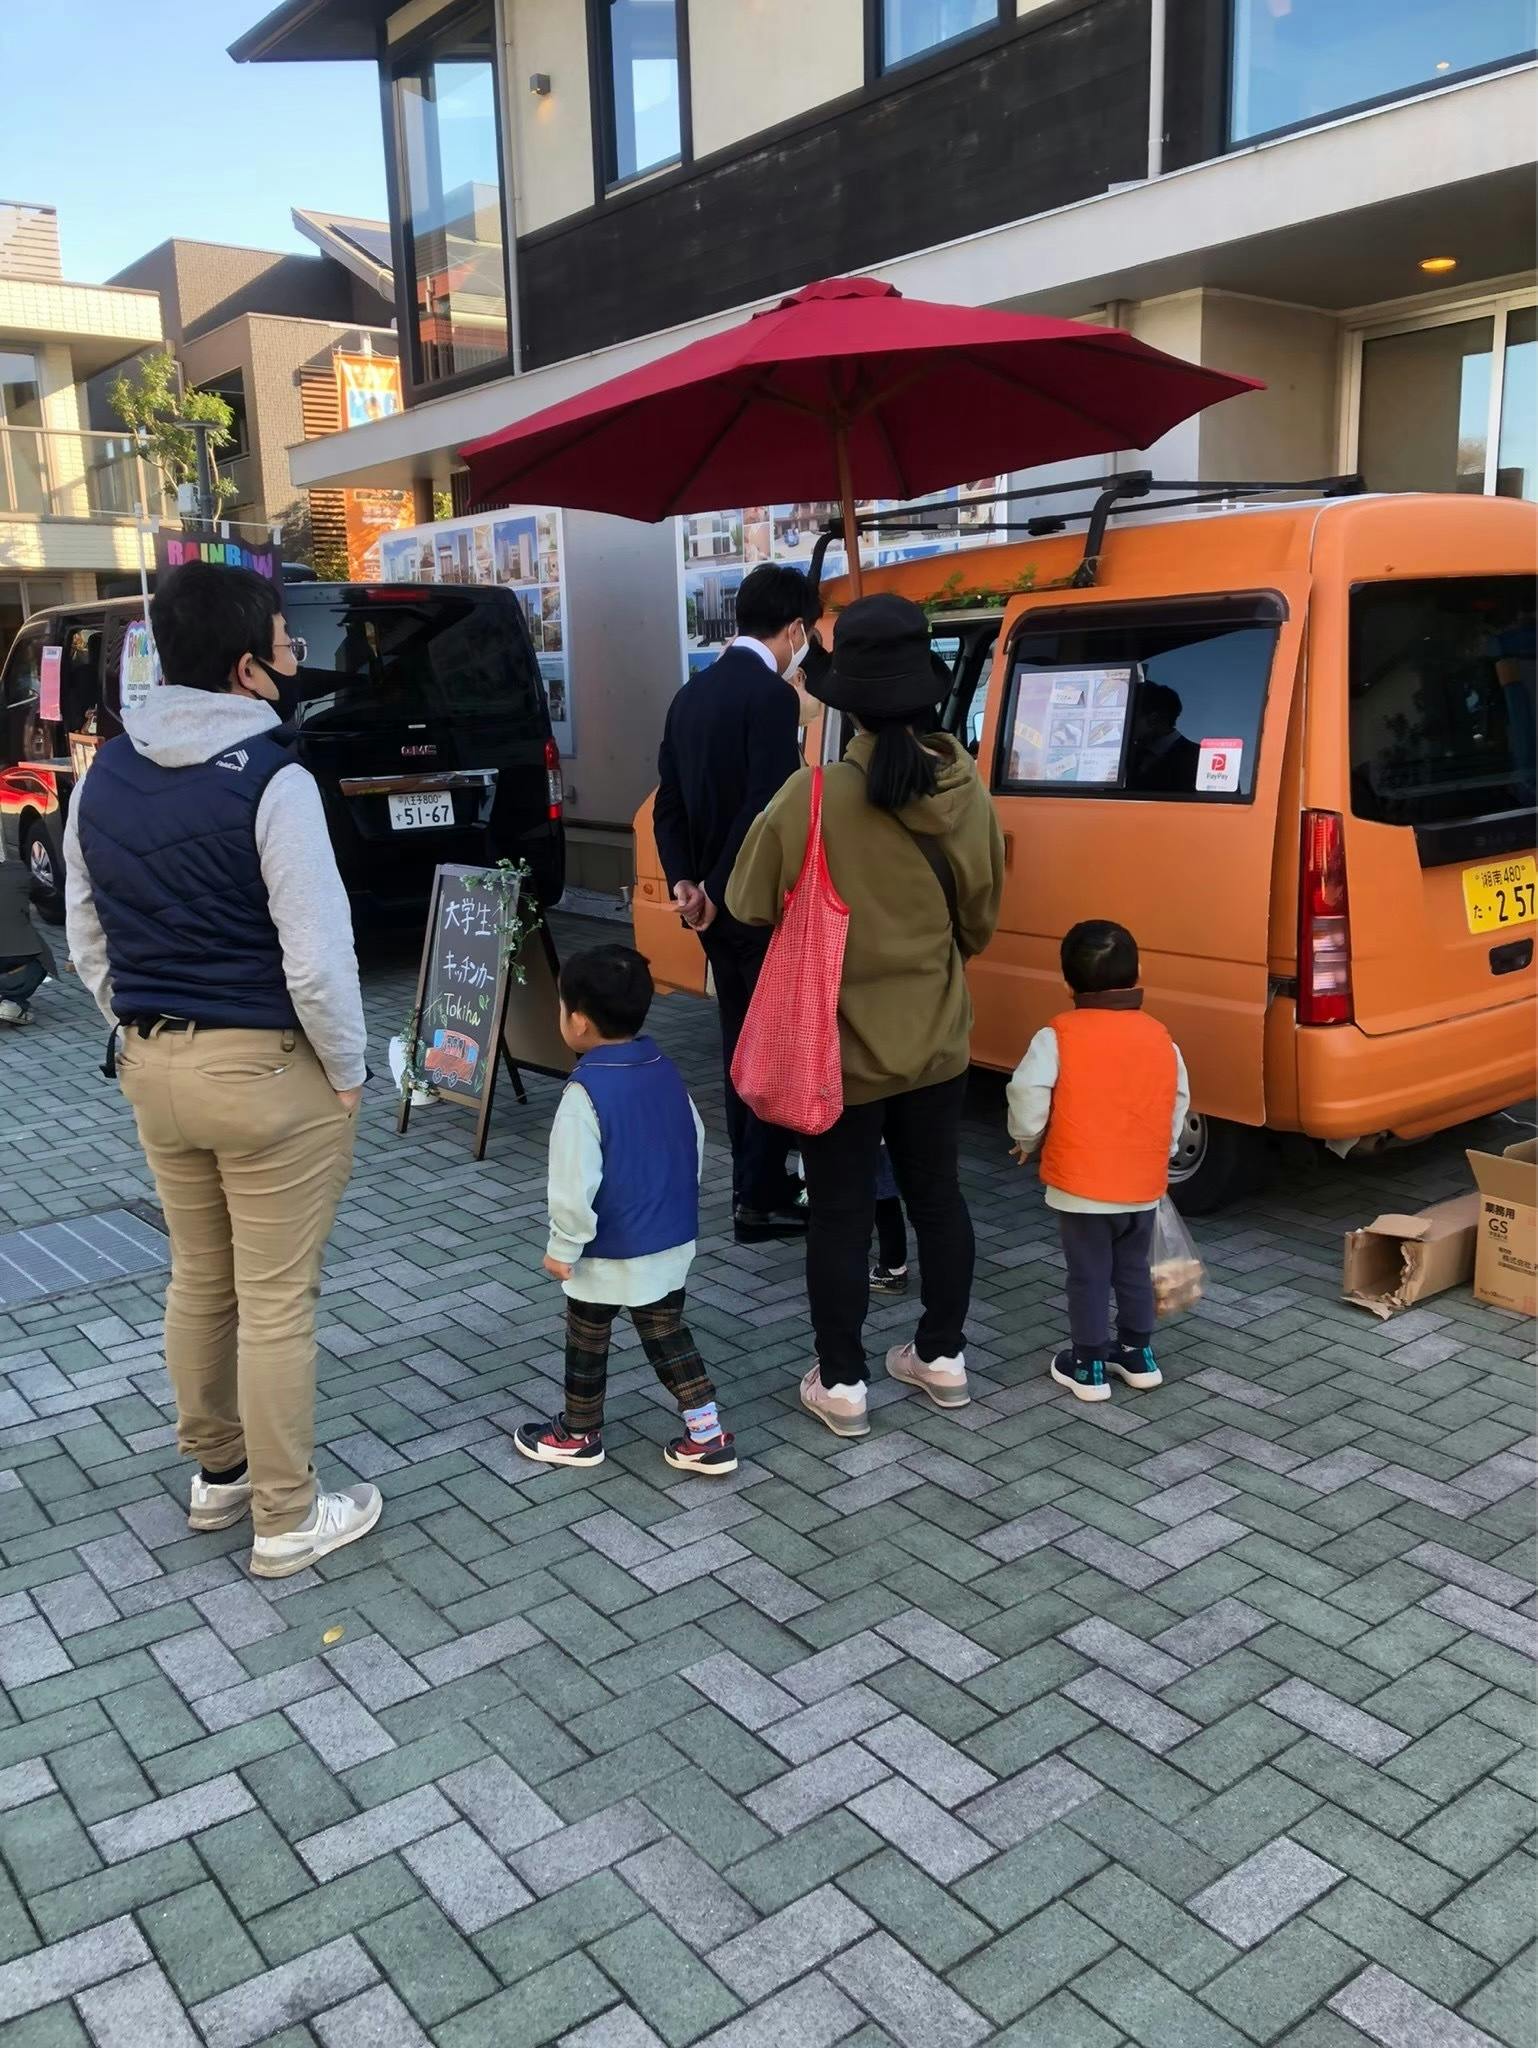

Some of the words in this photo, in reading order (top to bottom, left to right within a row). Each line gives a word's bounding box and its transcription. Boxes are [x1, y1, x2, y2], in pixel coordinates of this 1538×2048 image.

[404, 804, 449, 825] 51-67
[444, 898, 491, 936] 大学生
[443, 950, 495, 989] キッチンカー
[1488, 1218, 1508, 1234] GS
